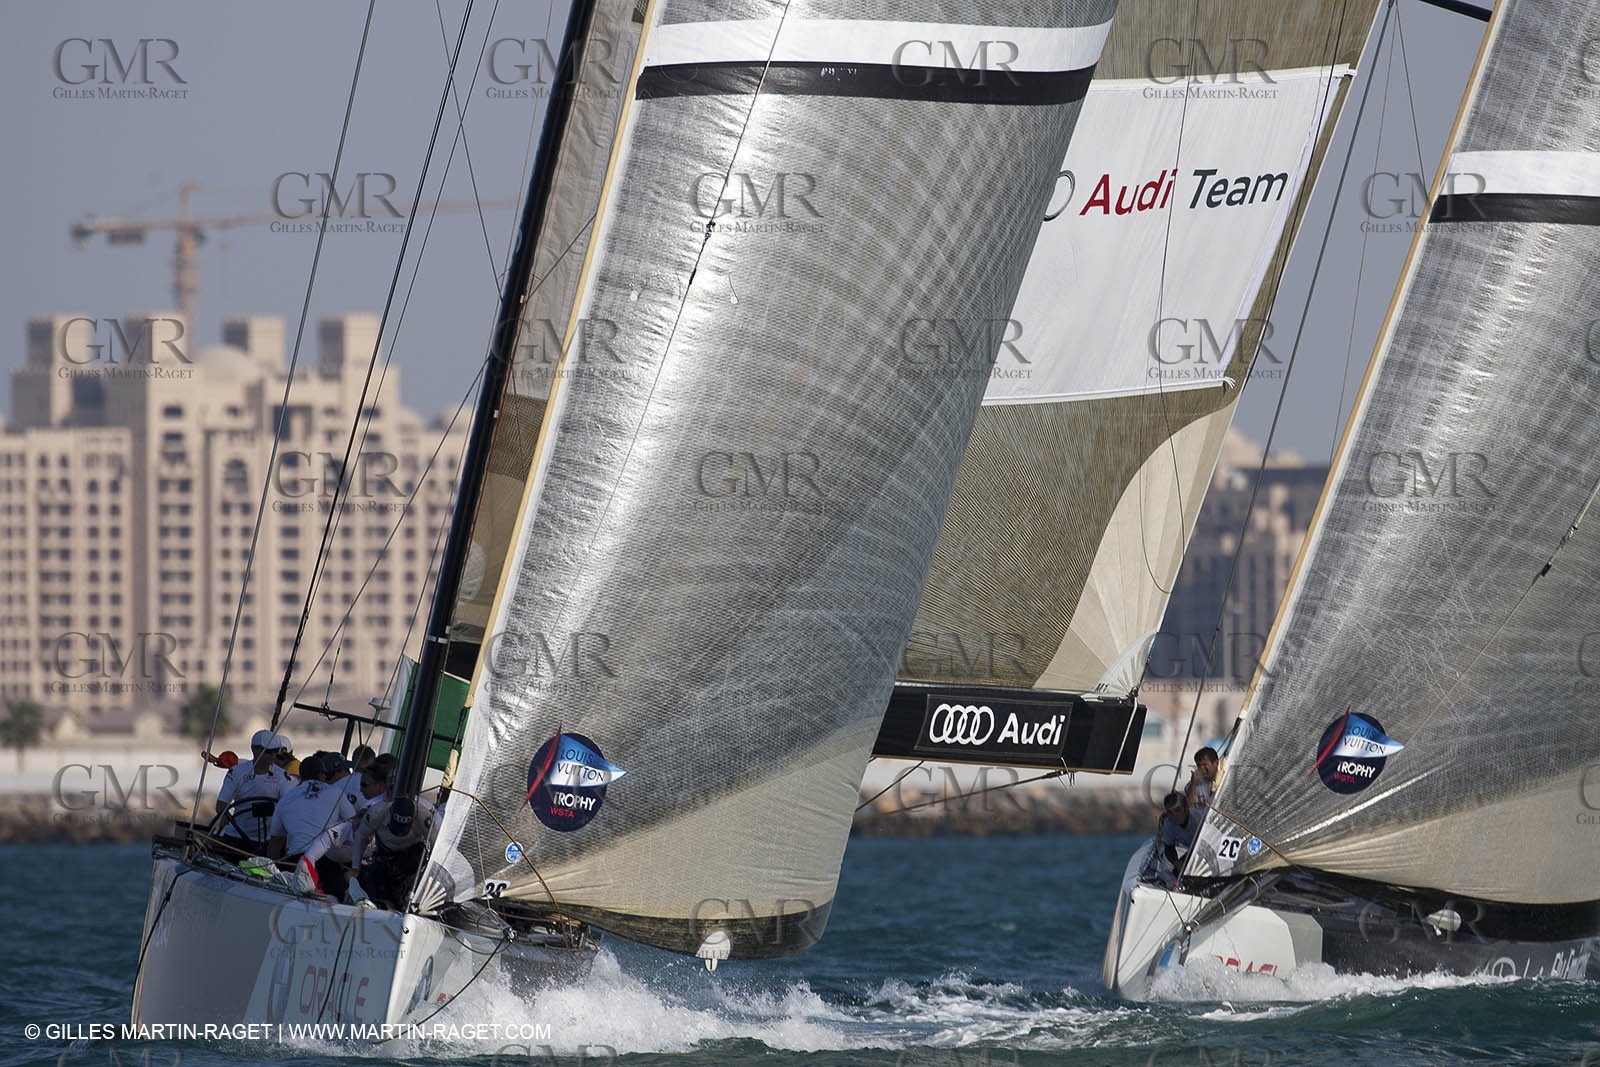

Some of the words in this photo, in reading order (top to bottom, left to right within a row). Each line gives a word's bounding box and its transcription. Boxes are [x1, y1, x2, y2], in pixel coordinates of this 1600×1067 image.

[1080, 168, 1178, 216] Audi
[1189, 168, 1289, 209] Team
[997, 712, 1065, 746] Audi
[1349, 726, 1376, 738] OUIS
[560, 748, 593, 764] LOUIS
[1343, 737, 1386, 755] VUITTON
[557, 762, 604, 782] VUITTON
[1337, 761, 1376, 779] TROPHY
[553, 791, 597, 812] TROPHY
[1219, 839, 1240, 859] 2C
